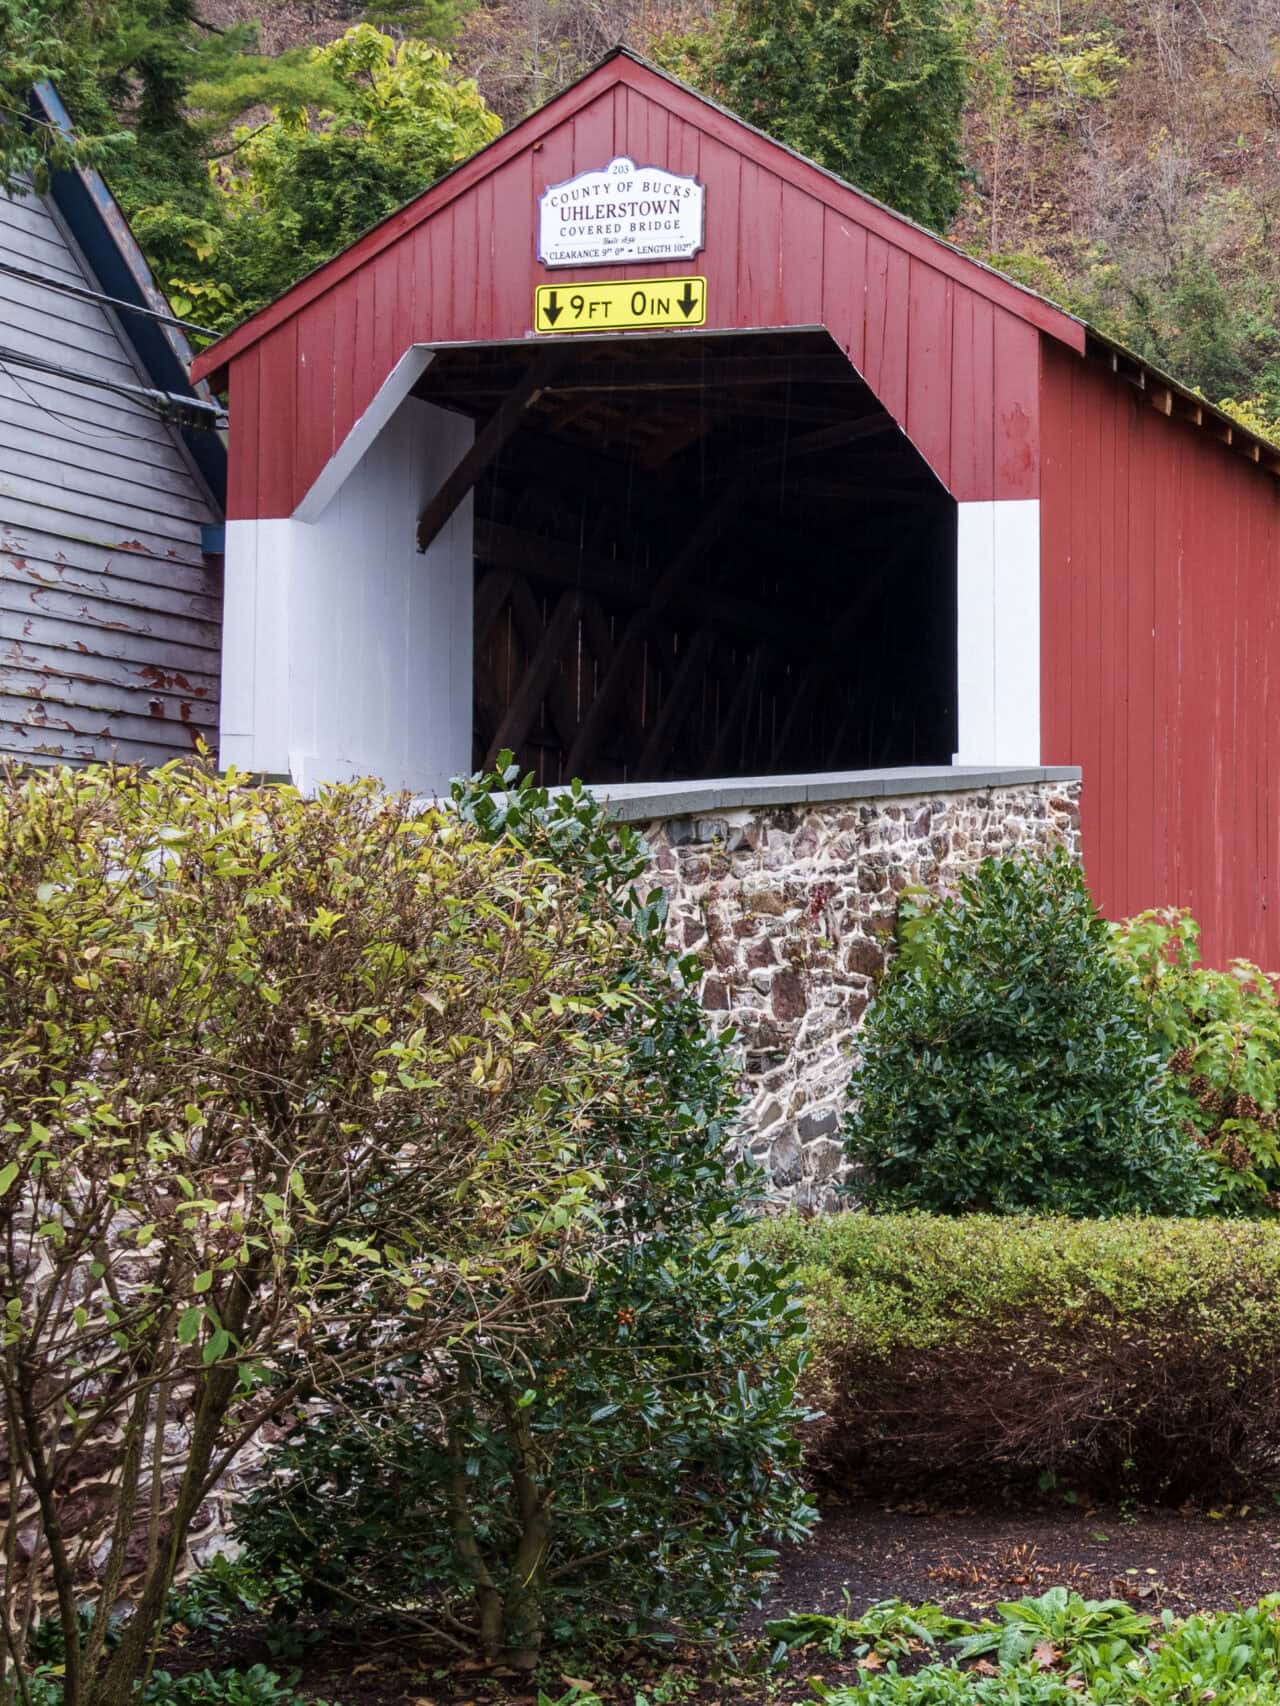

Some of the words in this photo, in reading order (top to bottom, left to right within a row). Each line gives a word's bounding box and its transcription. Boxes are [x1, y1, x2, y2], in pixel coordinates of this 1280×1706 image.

[551, 183, 611, 207] COUNTY
[617, 182, 633, 193] OF
[642, 181, 691, 199] BUCKS
[560, 199, 680, 222] UHLERSTOWN
[560, 223, 621, 237] COVERED
[630, 220, 681, 232] BRIDGE
[549, 248, 600, 260] CLEARANCE
[637, 245, 671, 255] LENGTH
